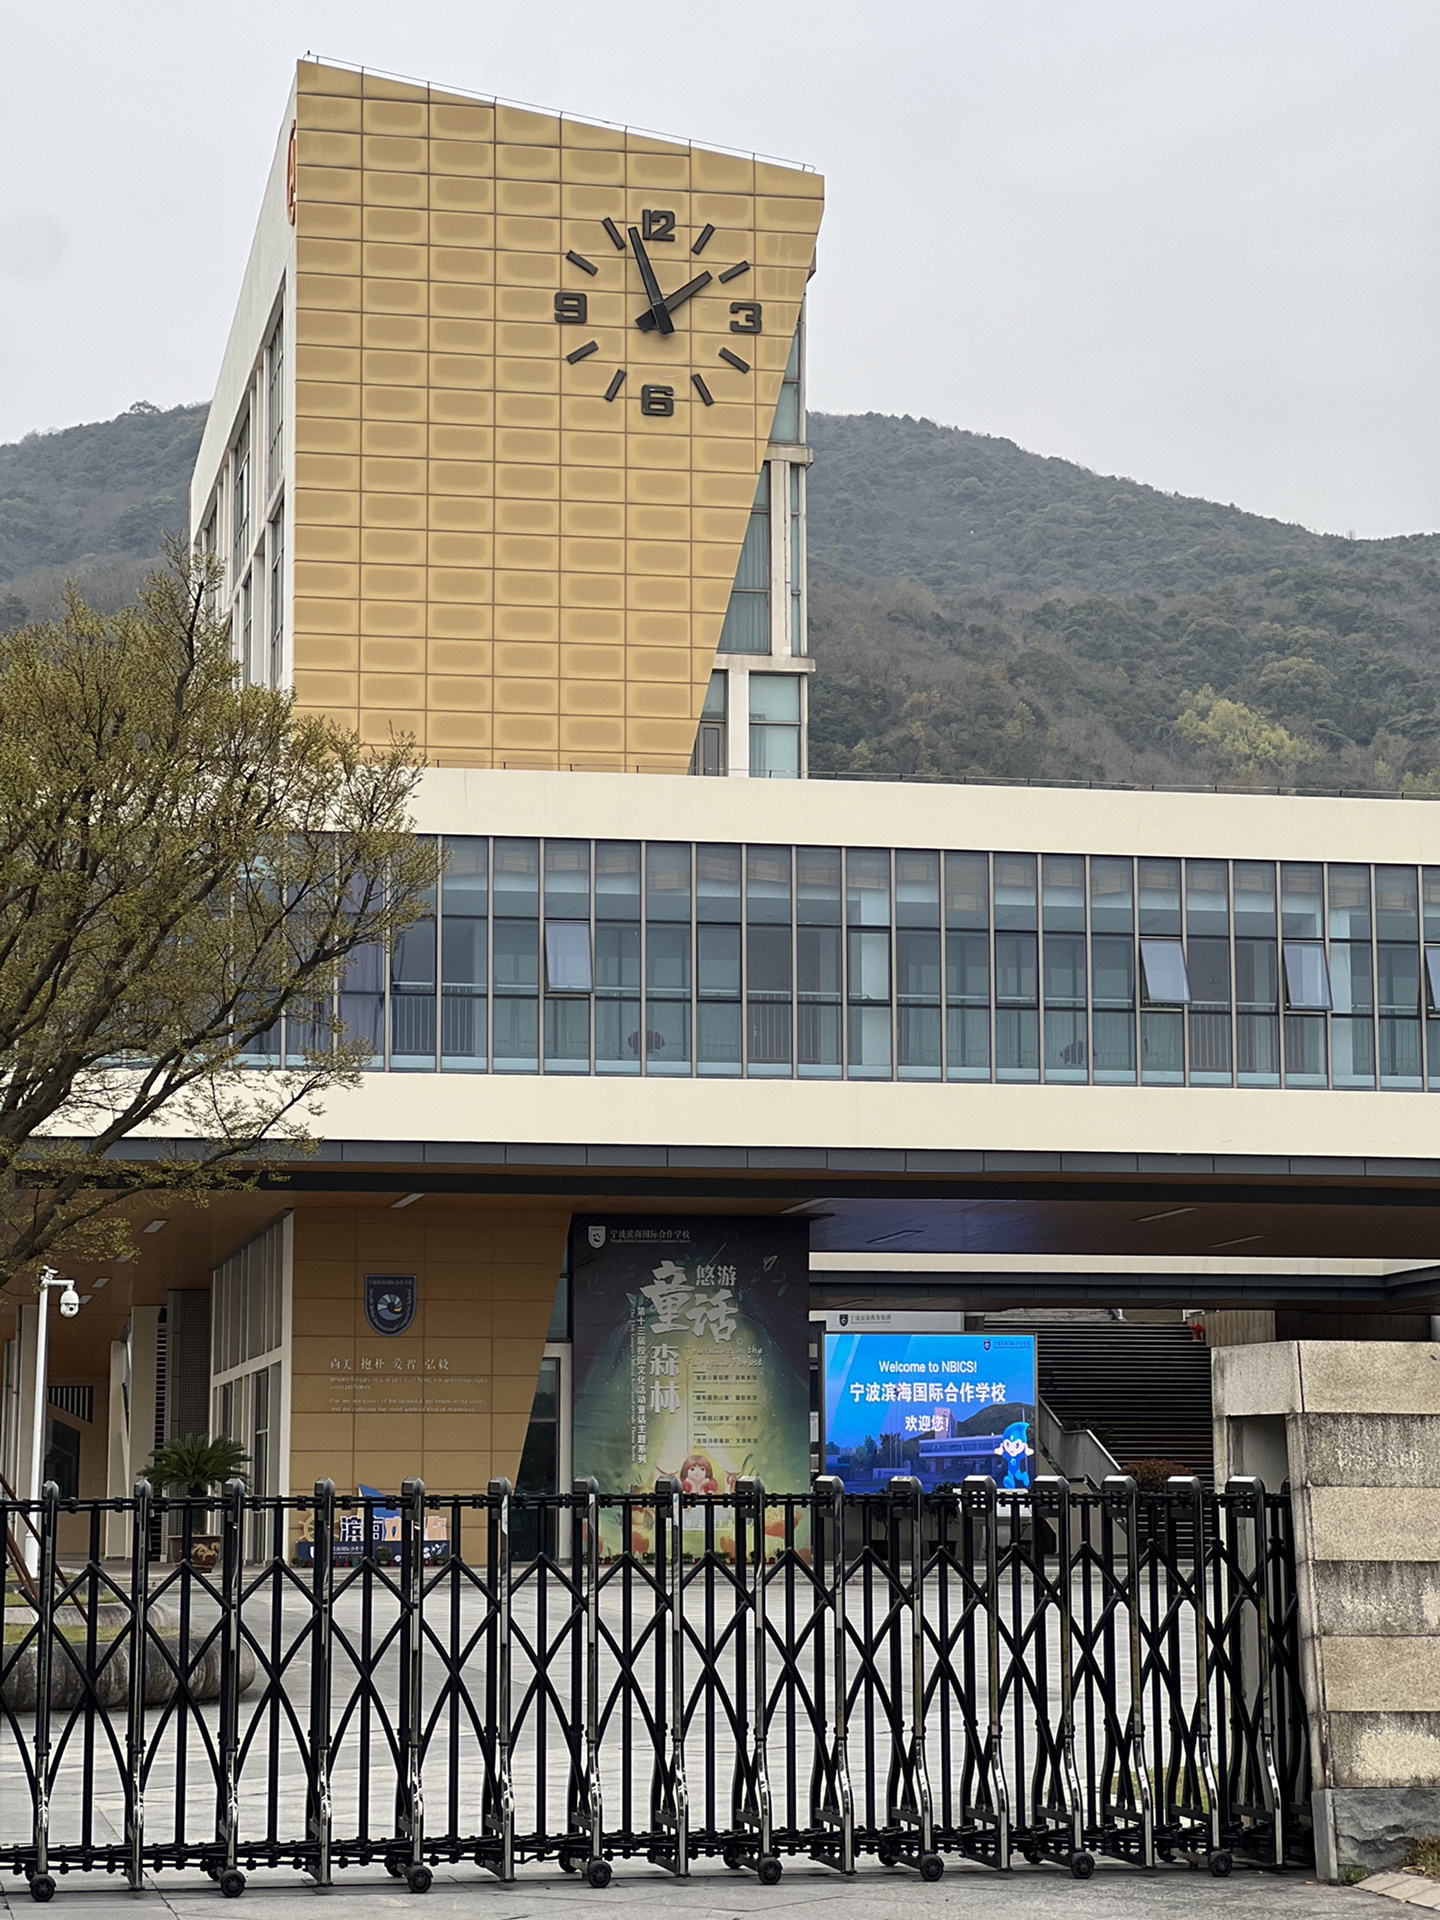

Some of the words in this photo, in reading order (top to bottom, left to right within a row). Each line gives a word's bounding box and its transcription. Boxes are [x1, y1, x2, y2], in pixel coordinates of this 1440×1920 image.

[642, 209, 675, 242] 12
[554, 291, 587, 324] 9
[730, 302, 762, 333] 3
[641, 384, 674, 417] 6
[696, 1265, 737, 1286] 悠游
[640, 1260, 738, 1344] 童话
[649, 1343, 680, 1414] 森林
[878, 1360, 926, 1373] Welcome
[928, 1362, 939, 1373] to
[941, 1360, 977, 1373] NBICS!
[849, 1381, 1006, 1403] 宁波滨海国际合作学校
